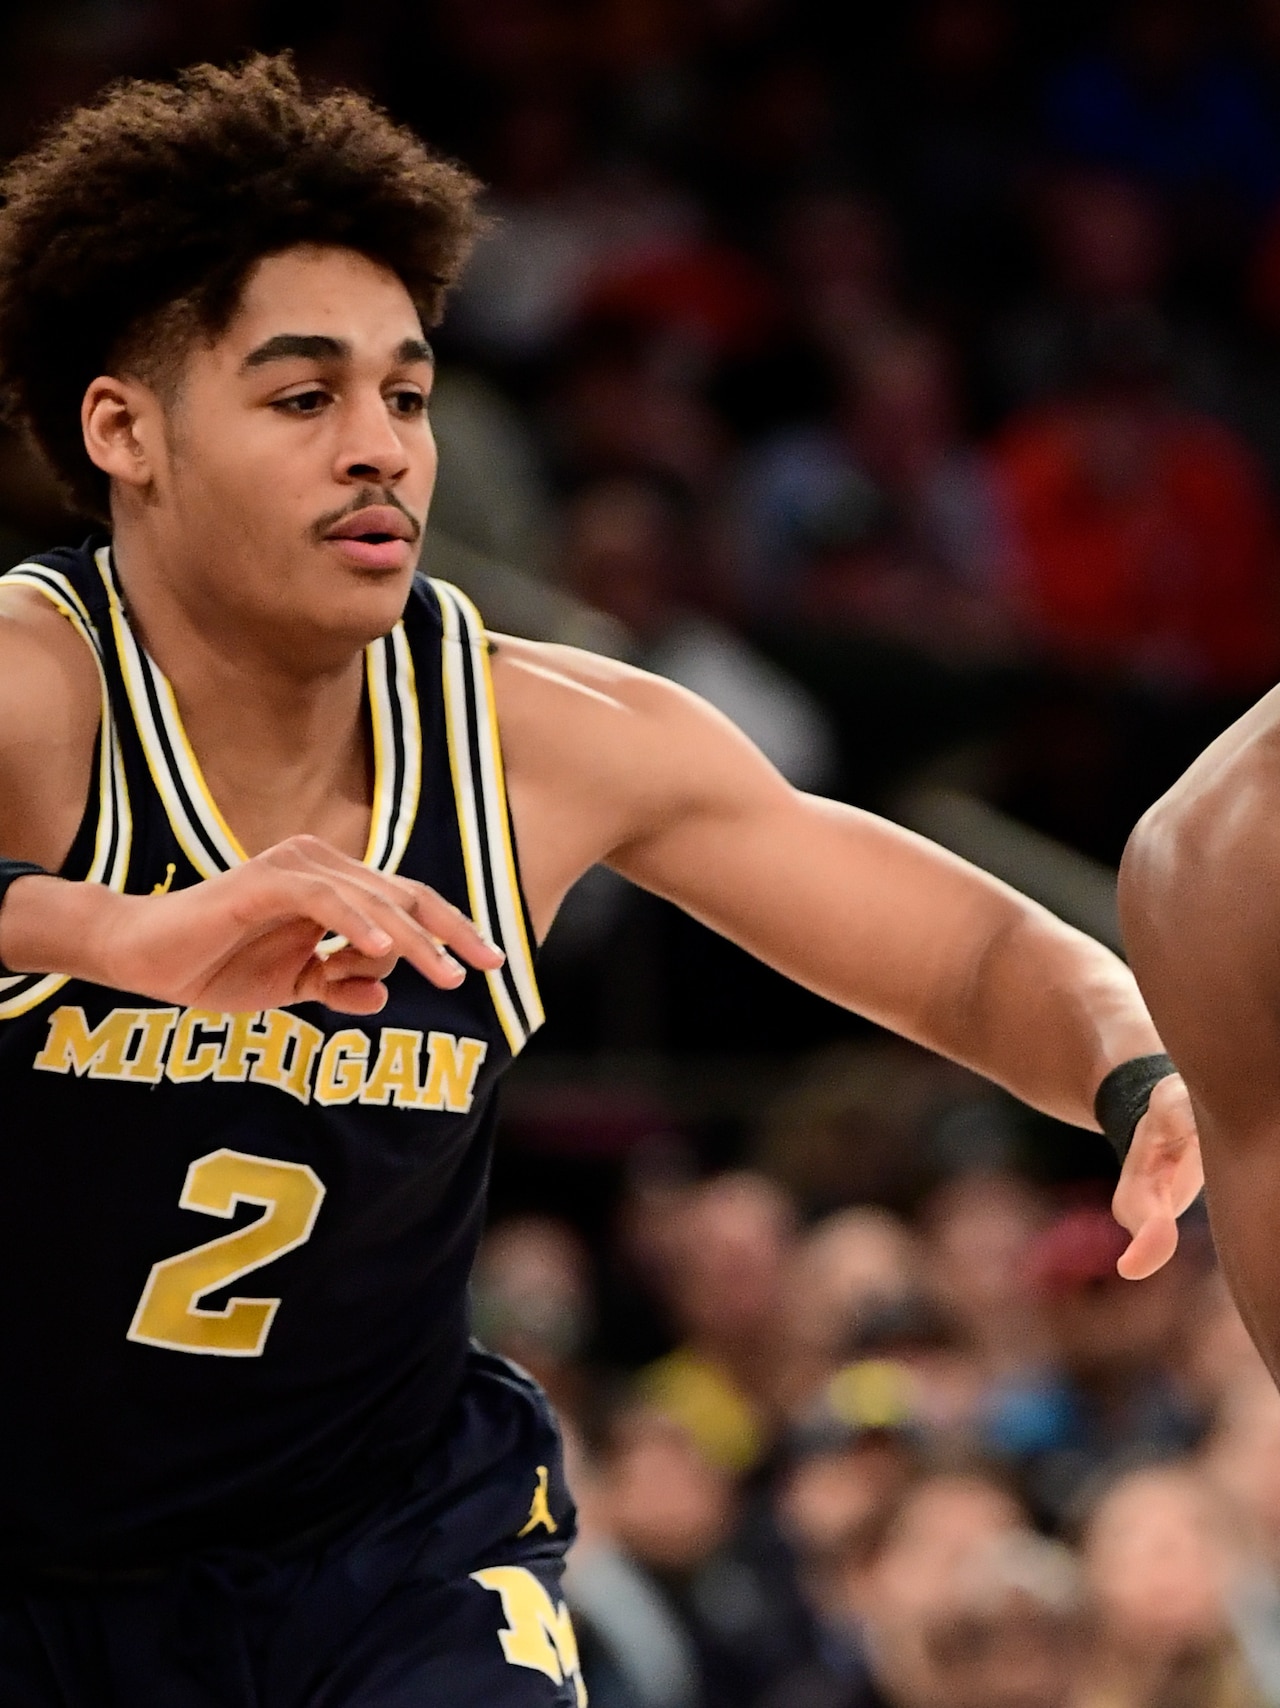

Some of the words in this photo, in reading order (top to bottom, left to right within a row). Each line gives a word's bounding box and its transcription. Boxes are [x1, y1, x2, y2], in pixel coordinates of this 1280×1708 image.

[33, 1006, 487, 1113] MICHIGAN
[126, 1148, 326, 1357] 2
[468, 1565, 589, 1708] M
